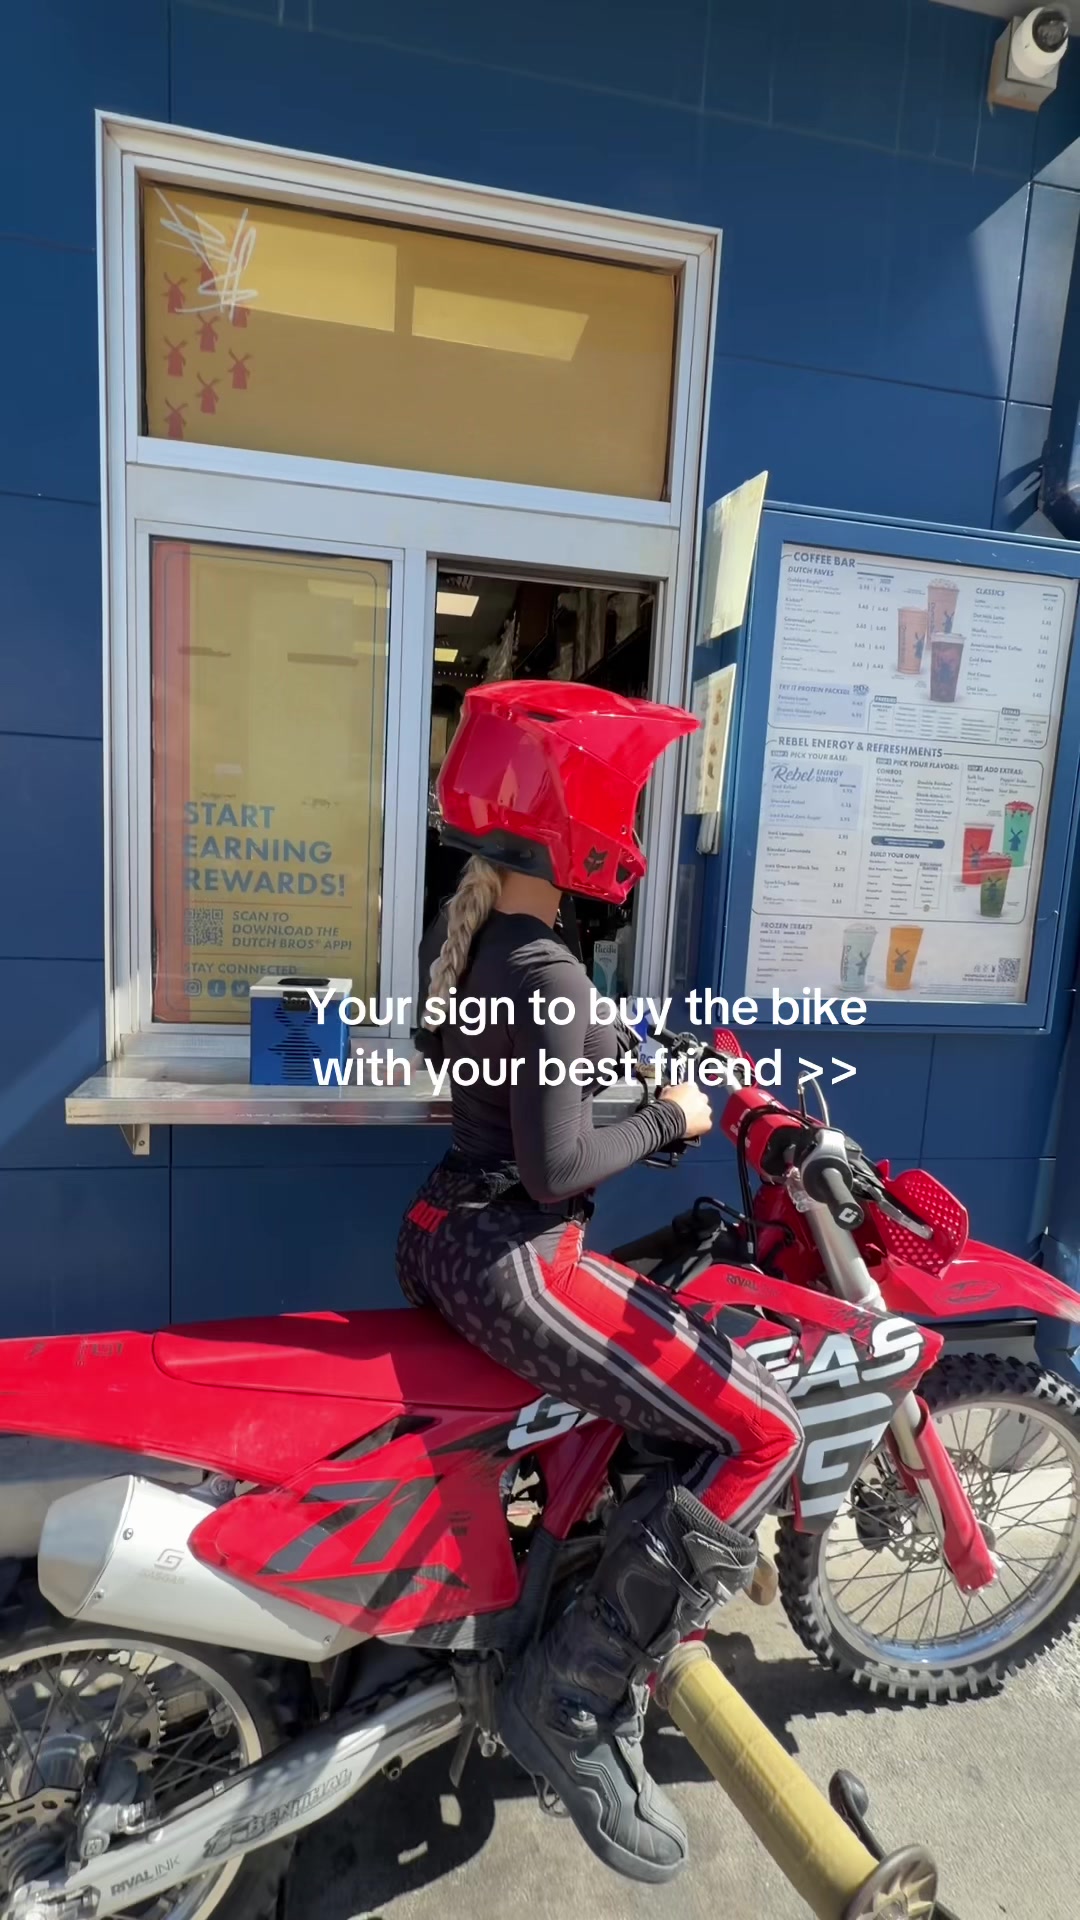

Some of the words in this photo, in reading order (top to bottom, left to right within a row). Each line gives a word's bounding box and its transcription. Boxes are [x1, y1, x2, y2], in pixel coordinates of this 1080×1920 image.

[793, 552, 832, 565] COFFEE
[834, 556, 856, 568] BAR
[788, 566, 813, 575] DUTCH
[814, 568, 834, 577] FAVES
[975, 587, 1006, 597] CLASSICS
[797, 685, 824, 693] PROTEIN
[778, 737, 809, 747] REBEL
[812, 738, 855, 751] ENERGY
[856, 742, 864, 751] &
[866, 743, 943, 758] REFRESHMENTS
[893, 758, 908, 767] PICK
[771, 764, 816, 783] Rebel
[184, 801, 275, 828] START
[184, 835, 332, 864] EARNING
[184, 868, 345, 897] REWARDS!
[232, 911, 269, 922] SCAN
[272, 912, 289, 922] TO
[232, 924, 313, 936] DOWNLOAD
[317, 927, 340, 937] THE
[232, 938, 276, 948] DUTCH
[324, 940, 352, 950] APP!
[184, 963, 214, 974] STAY
[218, 964, 297, 975] CONNECTED
